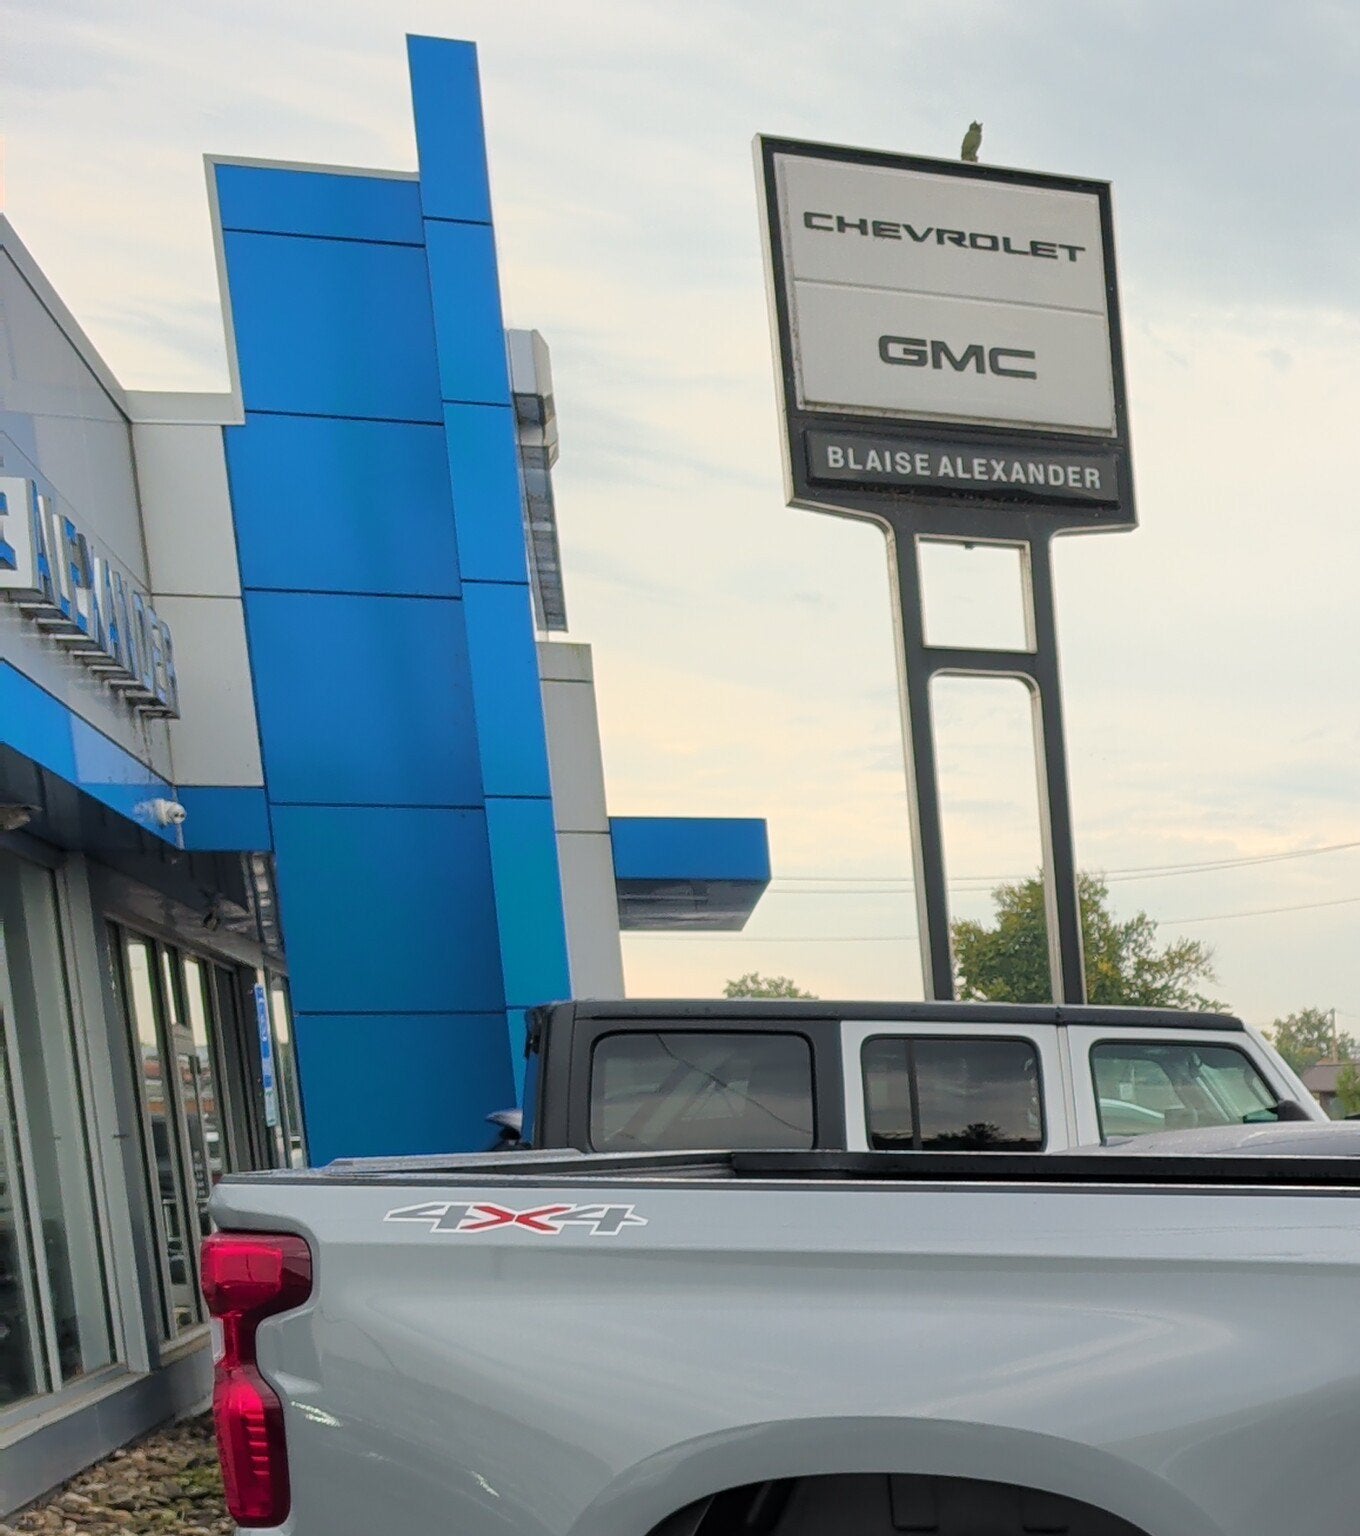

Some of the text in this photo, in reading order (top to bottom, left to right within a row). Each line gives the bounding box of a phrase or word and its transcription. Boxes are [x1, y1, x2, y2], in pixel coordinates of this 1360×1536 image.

[803, 211, 1086, 262] CHEVROLET
[878, 334, 1037, 380] GMC
[827, 445, 1101, 490] BLAISE ALEXANDER
